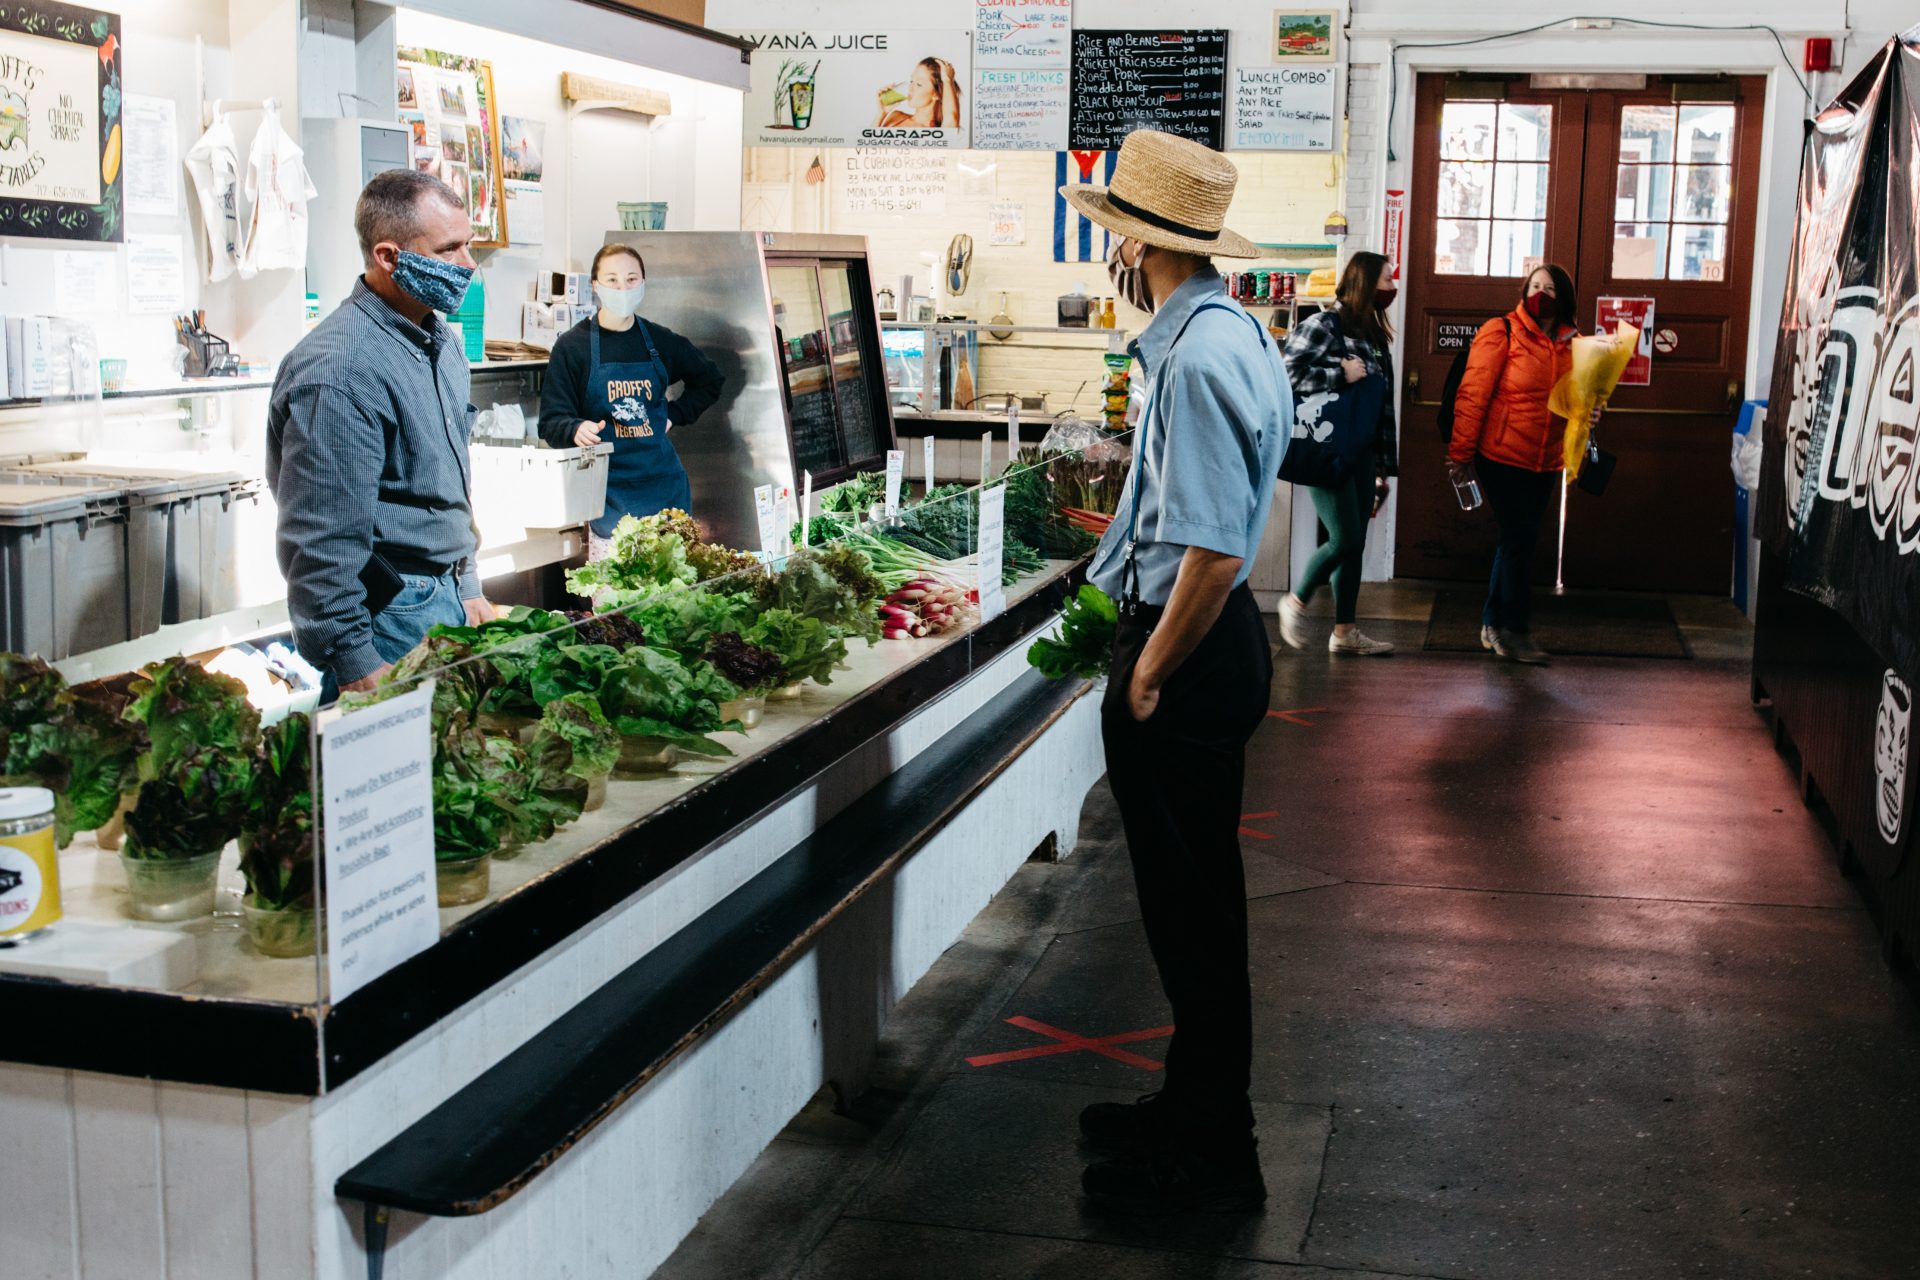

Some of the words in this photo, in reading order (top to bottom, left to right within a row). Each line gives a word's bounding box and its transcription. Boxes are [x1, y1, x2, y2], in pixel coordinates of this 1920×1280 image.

[824, 35, 888, 49] JUICE
[980, 31, 1004, 42] BEEF
[1107, 37, 1124, 47] AND
[1125, 33, 1161, 47] BEANS
[978, 43, 998, 55] HAM
[1001, 47, 1014, 55] AND
[982, 71, 1016, 83] FRESH
[1021, 71, 1064, 84] DRINKS
[1079, 69, 1111, 82] ROAST
[1114, 67, 1142, 81] PORK
[1240, 70, 1279, 83] LUNCH
[1281, 70, 1326, 84] COMBO
[1238, 86, 1258, 95] ANY
[1260, 86, 1283, 95] MEAT
[59, 94, 73, 108] NO
[1078, 95, 1109, 108] BLACK
[1112, 95, 1138, 107] BEAN
[1138, 94, 1166, 107] SOUP
[1238, 97, 1257, 106] ANY
[1238, 109, 1262, 117] YUCCA
[51, 126, 80, 142] SPRAYS
[759, 136, 844, 145] havanajuice@gmail.com
[862, 129, 944, 139] GUARAPO
[893, 139, 918, 147] CANE
[1077, 135, 1110, 148] Dipping
[847, 158, 860, 170] EL
[864, 157, 902, 170] CUBANO
[847, 187, 867, 197] MON
[995, 222, 1016, 233] HOT
[1705, 266, 1720, 279] 10
[1439, 325, 1479, 335] CENTRA
[1439, 337, 1463, 347] OPEN
[607, 379, 652, 403] GROFF'S
[612, 419, 654, 438] VEGETABLES
[331, 723, 376, 750] TEMPORARY
[345, 783, 367, 799] Please
[339, 808, 368, 826] Produce
[342, 902, 364, 922] Thank
[365, 897, 378, 910] you
[379, 889, 392, 901] for
[341, 923, 373, 948] patience
[374, 910, 394, 927] while
